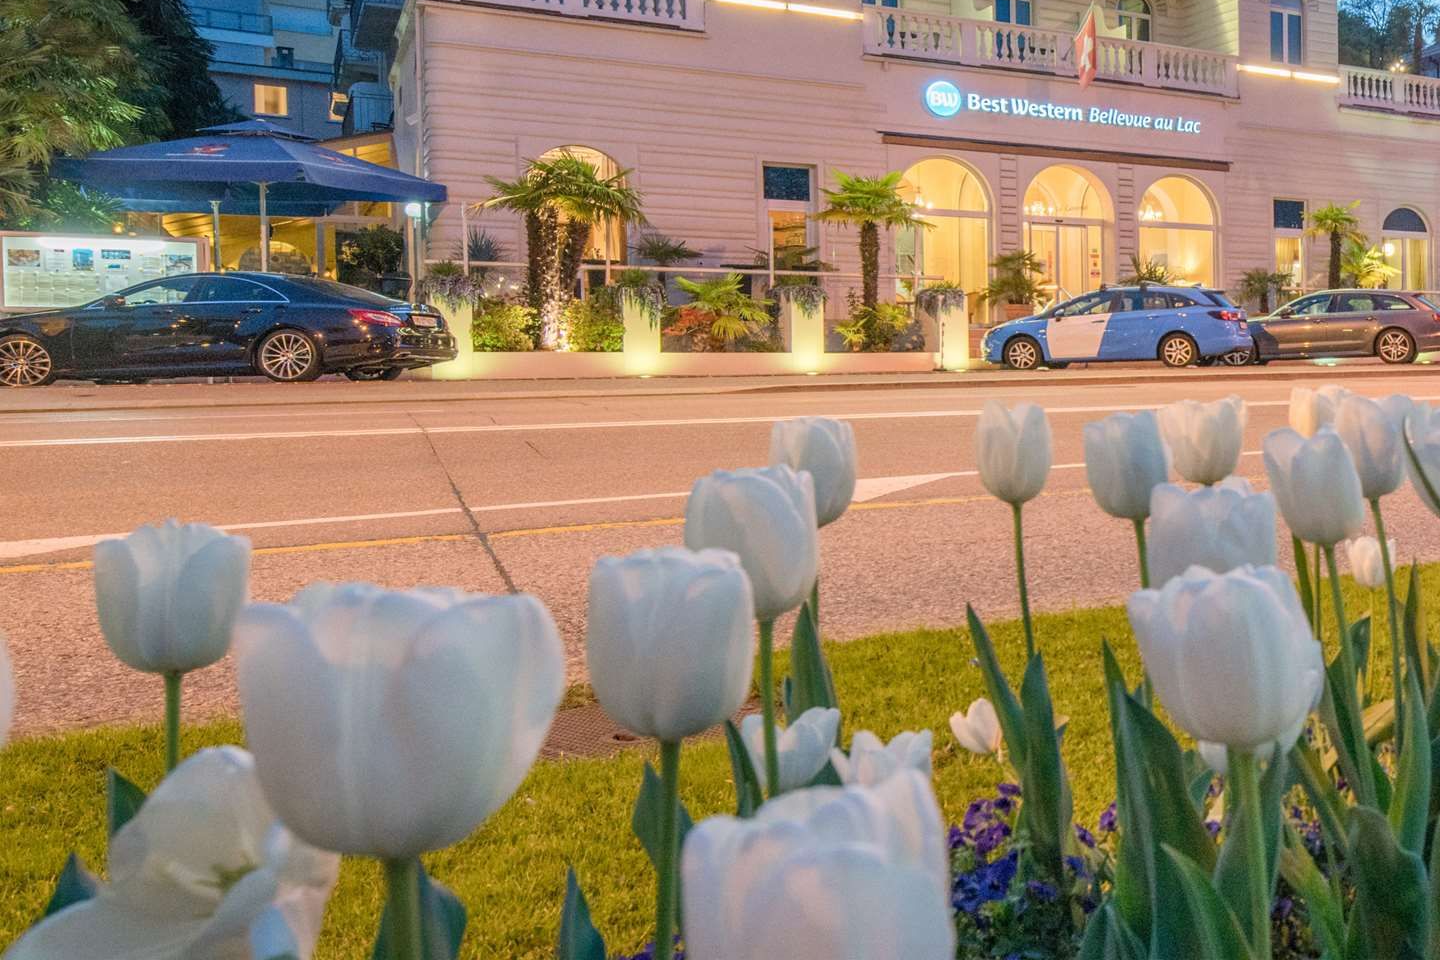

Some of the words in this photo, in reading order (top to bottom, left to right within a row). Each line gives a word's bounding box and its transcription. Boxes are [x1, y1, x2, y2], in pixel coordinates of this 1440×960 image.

[928, 89, 959, 109] BW
[967, 93, 1009, 113] Best
[1011, 97, 1083, 121] Western
[1089, 107, 1150, 128] Bellevue
[1154, 117, 1173, 131] au
[1176, 116, 1201, 134] Lac
